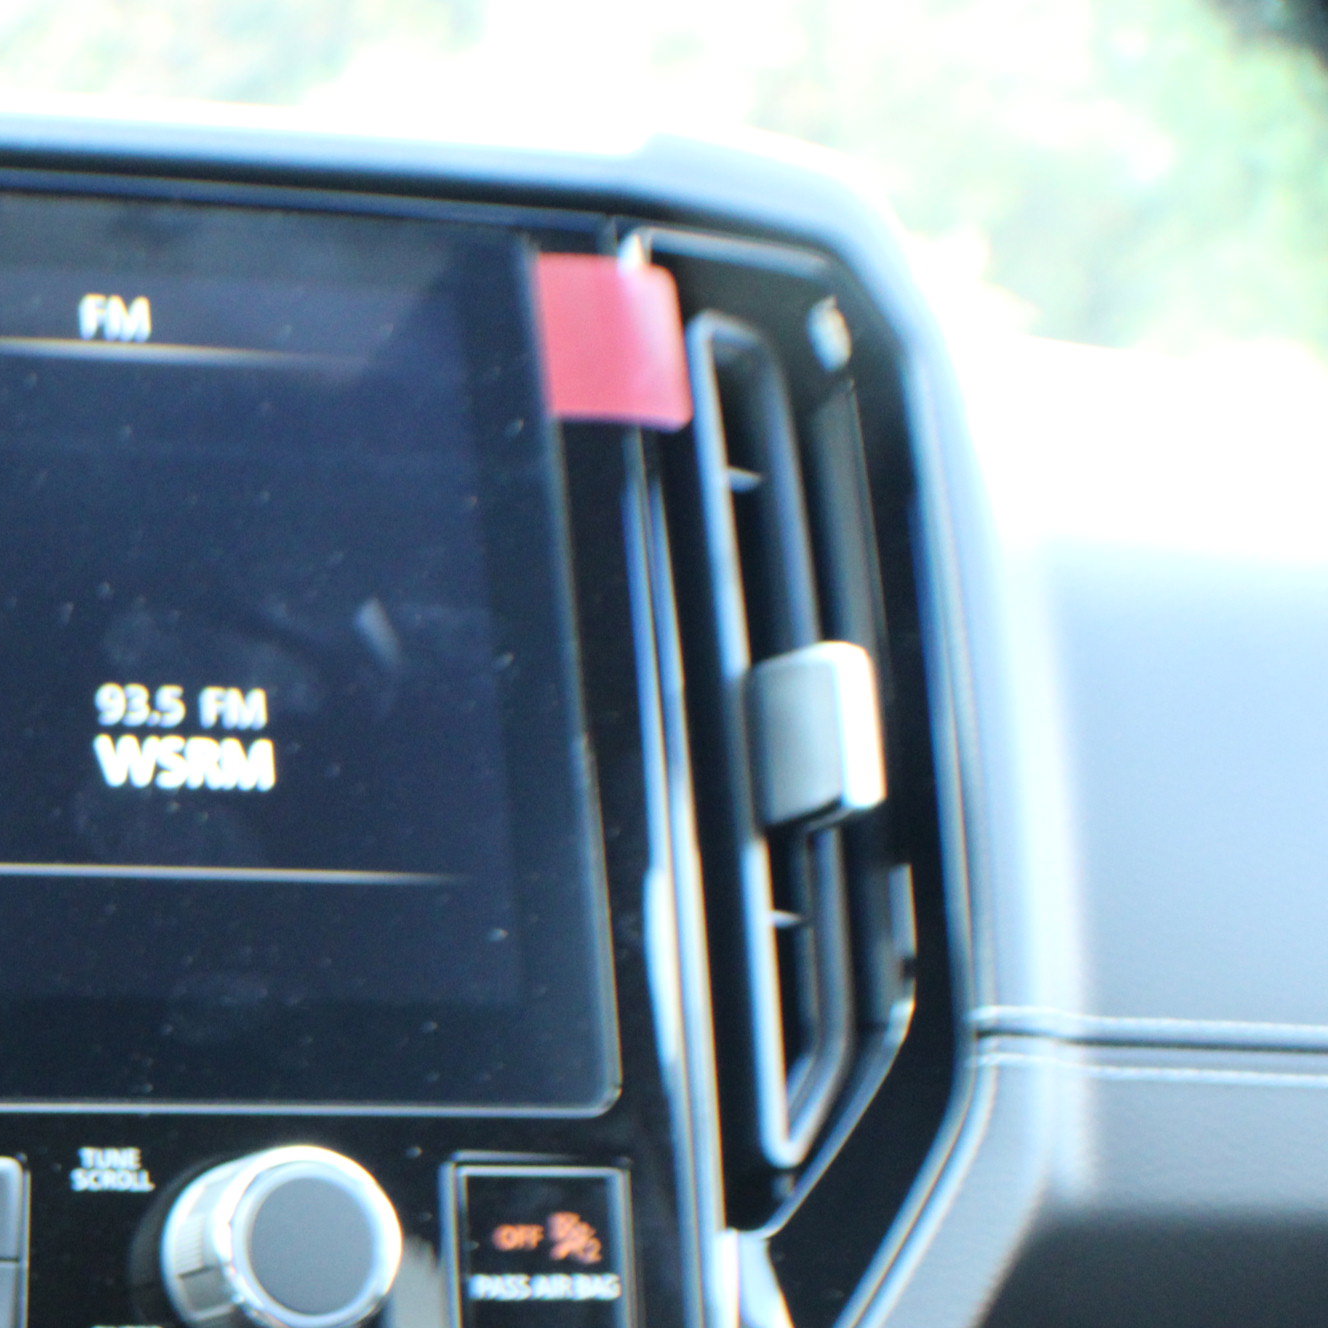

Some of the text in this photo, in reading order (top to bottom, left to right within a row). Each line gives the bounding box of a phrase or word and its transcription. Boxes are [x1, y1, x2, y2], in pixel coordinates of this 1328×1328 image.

[79, 293, 151, 341] FM
[94, 683, 266, 730] 93.5 FM
[93, 733, 275, 791] WSRM
[80, 1147, 141, 1169] TUNE
[71, 1169, 154, 1192] SCROLL
[492, 1224, 543, 1251] OFF
[468, 1274, 621, 1300] PASS AIR BAG
